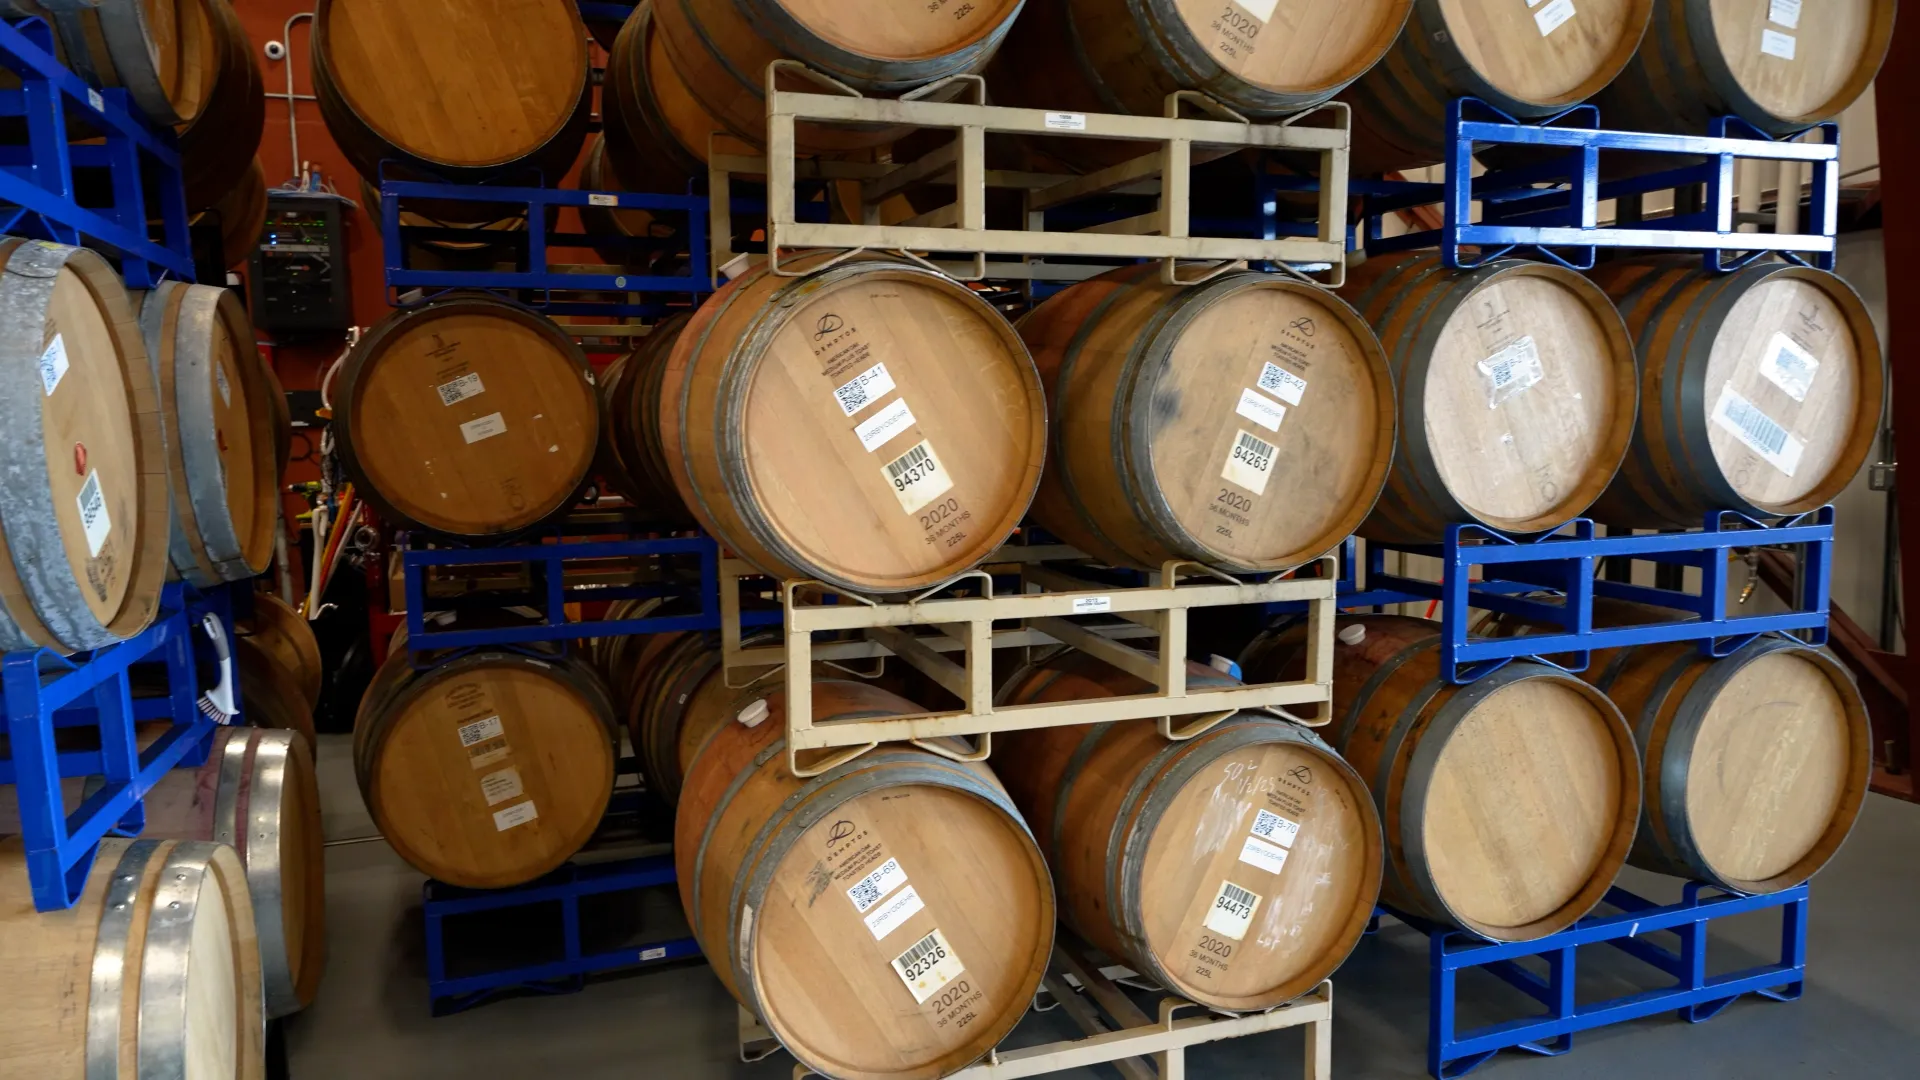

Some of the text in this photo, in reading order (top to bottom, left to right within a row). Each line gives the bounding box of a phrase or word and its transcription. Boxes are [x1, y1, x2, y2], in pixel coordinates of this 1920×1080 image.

[1221, 7, 1258, 38] 2020
[1220, 42, 1237, 59] 225L
[859, 366, 884, 386] B-41
[1283, 373, 1304, 391] B-42
[1234, 446, 1268, 471] 94263
[895, 458, 935, 491] 94370
[1217, 488, 1252, 512] 2020
[920, 498, 958, 530] 2020
[946, 532, 967, 547] 225L
[1216, 526, 1232, 538] 225L
[1276, 819, 1297, 834] B-70
[826, 830, 868, 862] DEMPTOS
[872, 860, 897, 883] B-69
[1216, 896, 1250, 919] 94473
[1199, 936, 1231, 957] 2020
[906, 947, 946, 981] 92326
[1196, 966, 1212, 978] 225L
[932, 981, 970, 1014] 2020
[956, 1012, 977, 1028] 225L
